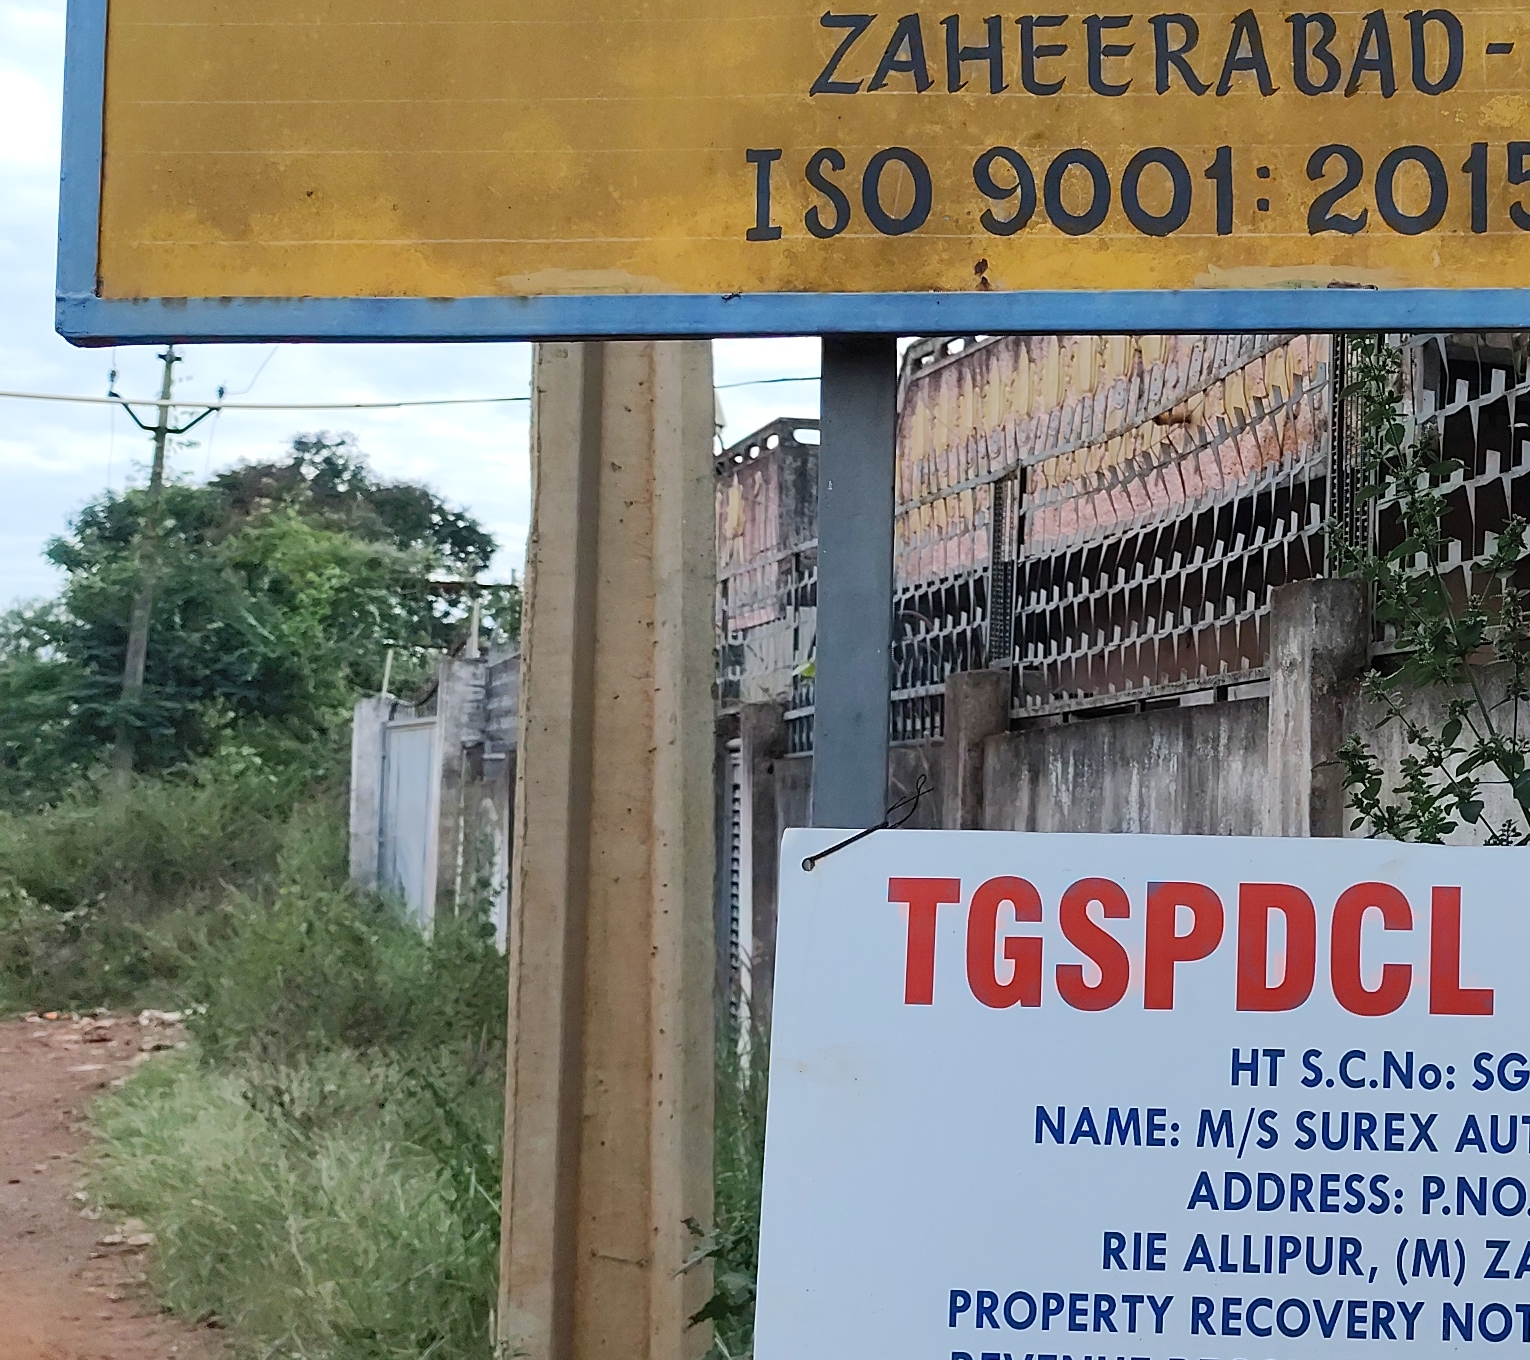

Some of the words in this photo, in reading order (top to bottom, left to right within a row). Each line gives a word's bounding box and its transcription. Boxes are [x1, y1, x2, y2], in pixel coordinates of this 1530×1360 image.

[745, 147, 932, 241] ISO
[973, 145, 1270, 237] 9001:
[888, 876, 1494, 1017] TGSPDCL
[1231, 1048, 1285, 1087] HT
[1301, 1049, 1456, 1091] S.C.No:
[1035, 1106, 1180, 1147] NAME:
[1198, 1108, 1278, 1158] M/S
[1295, 1110, 1438, 1153] SUREX
[1187, 1171, 1403, 1214] ADDRESS:
[1102, 1232, 1167, 1271] RIE
[1183, 1233, 1378, 1282] ALLIPUR,
[1396, 1237, 1465, 1285] (M)
[948, 1289, 1174, 1333] PROPERTY
[1191, 1296, 1424, 1340] RECOVERY
